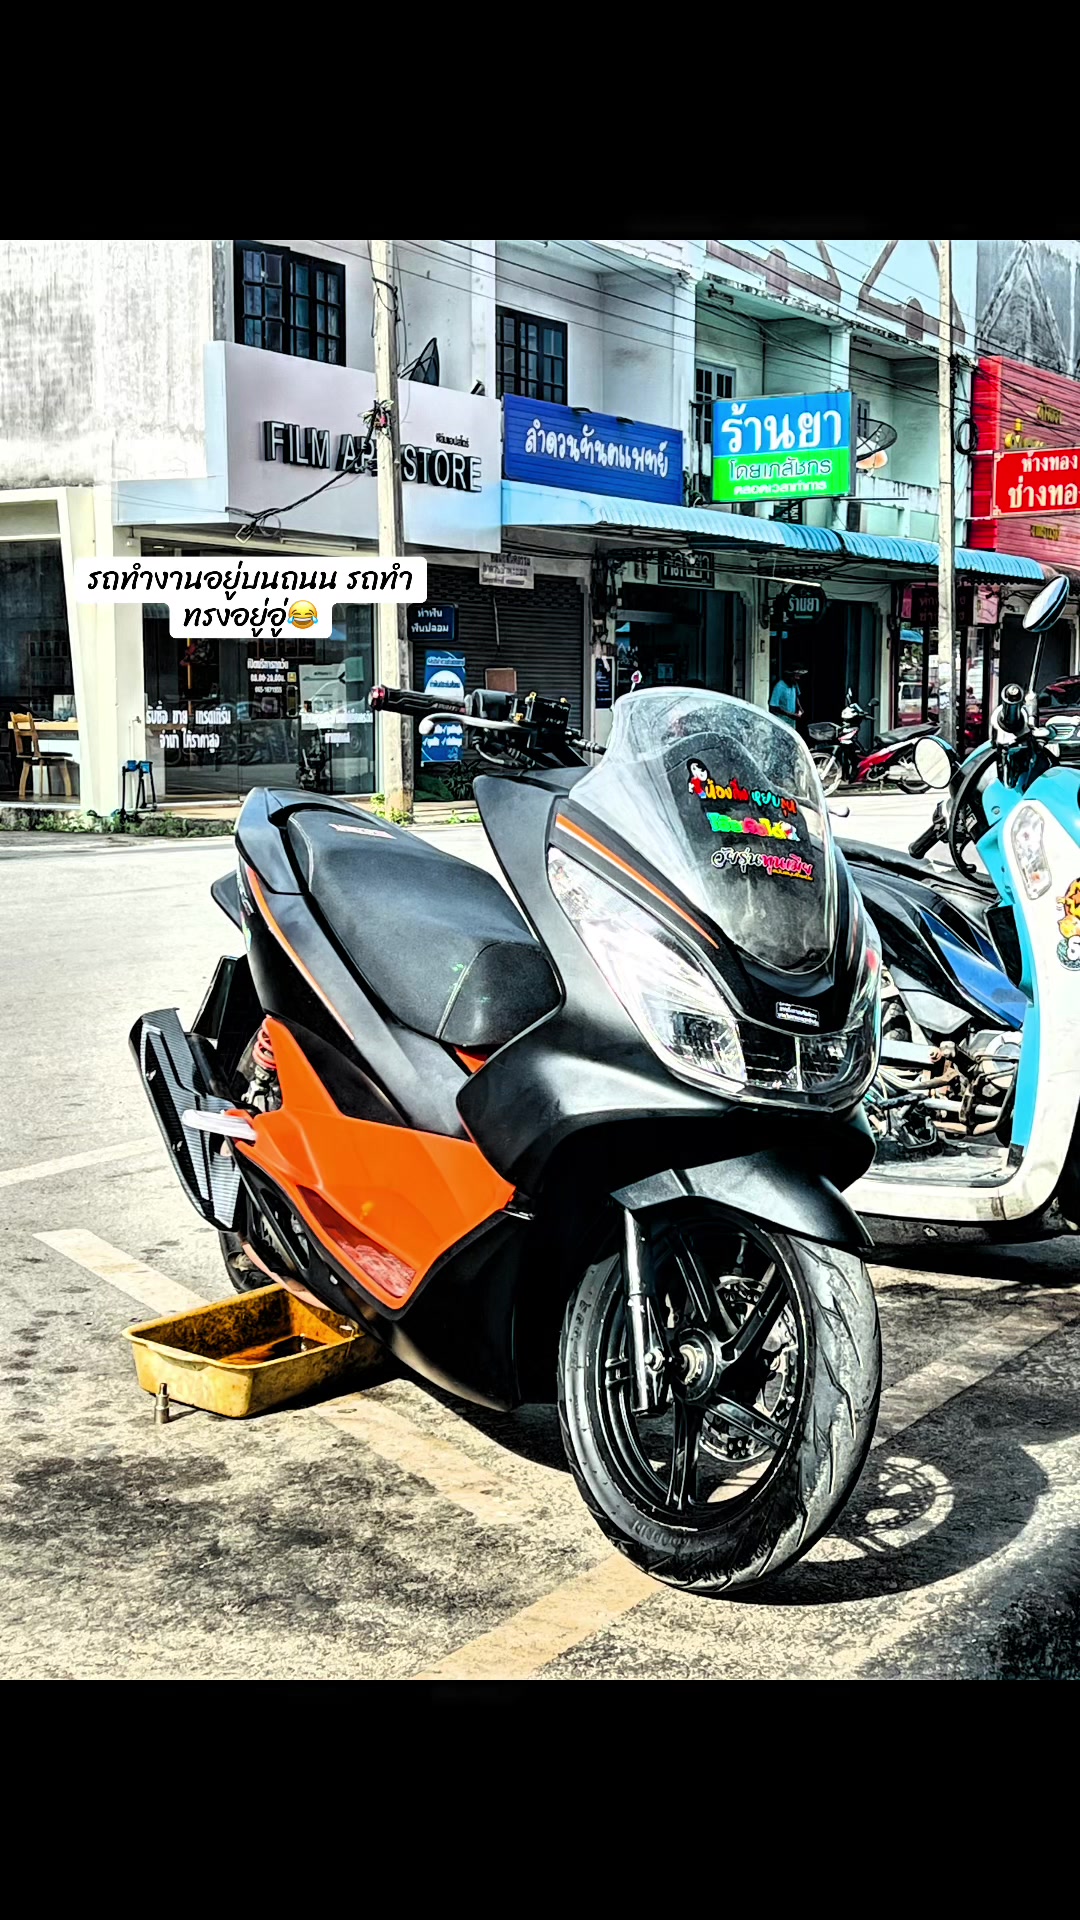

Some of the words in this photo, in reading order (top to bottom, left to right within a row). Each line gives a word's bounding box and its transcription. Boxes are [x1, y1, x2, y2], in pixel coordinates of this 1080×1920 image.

[721, 403, 842, 453] ร้านยา
[264, 421, 330, 469] FILM
[336, 434, 378, 475] AP
[401, 443, 482, 492] STORE
[525, 418, 669, 478] ลำดวนทันตแพทย์
[1021, 450, 1078, 473] ห้างทอง
[729, 458, 832, 481] โดยเภสัชกร
[1008, 475, 1080, 509] ช่างทอ
[411, 622, 449, 633] ฟันปลอม
